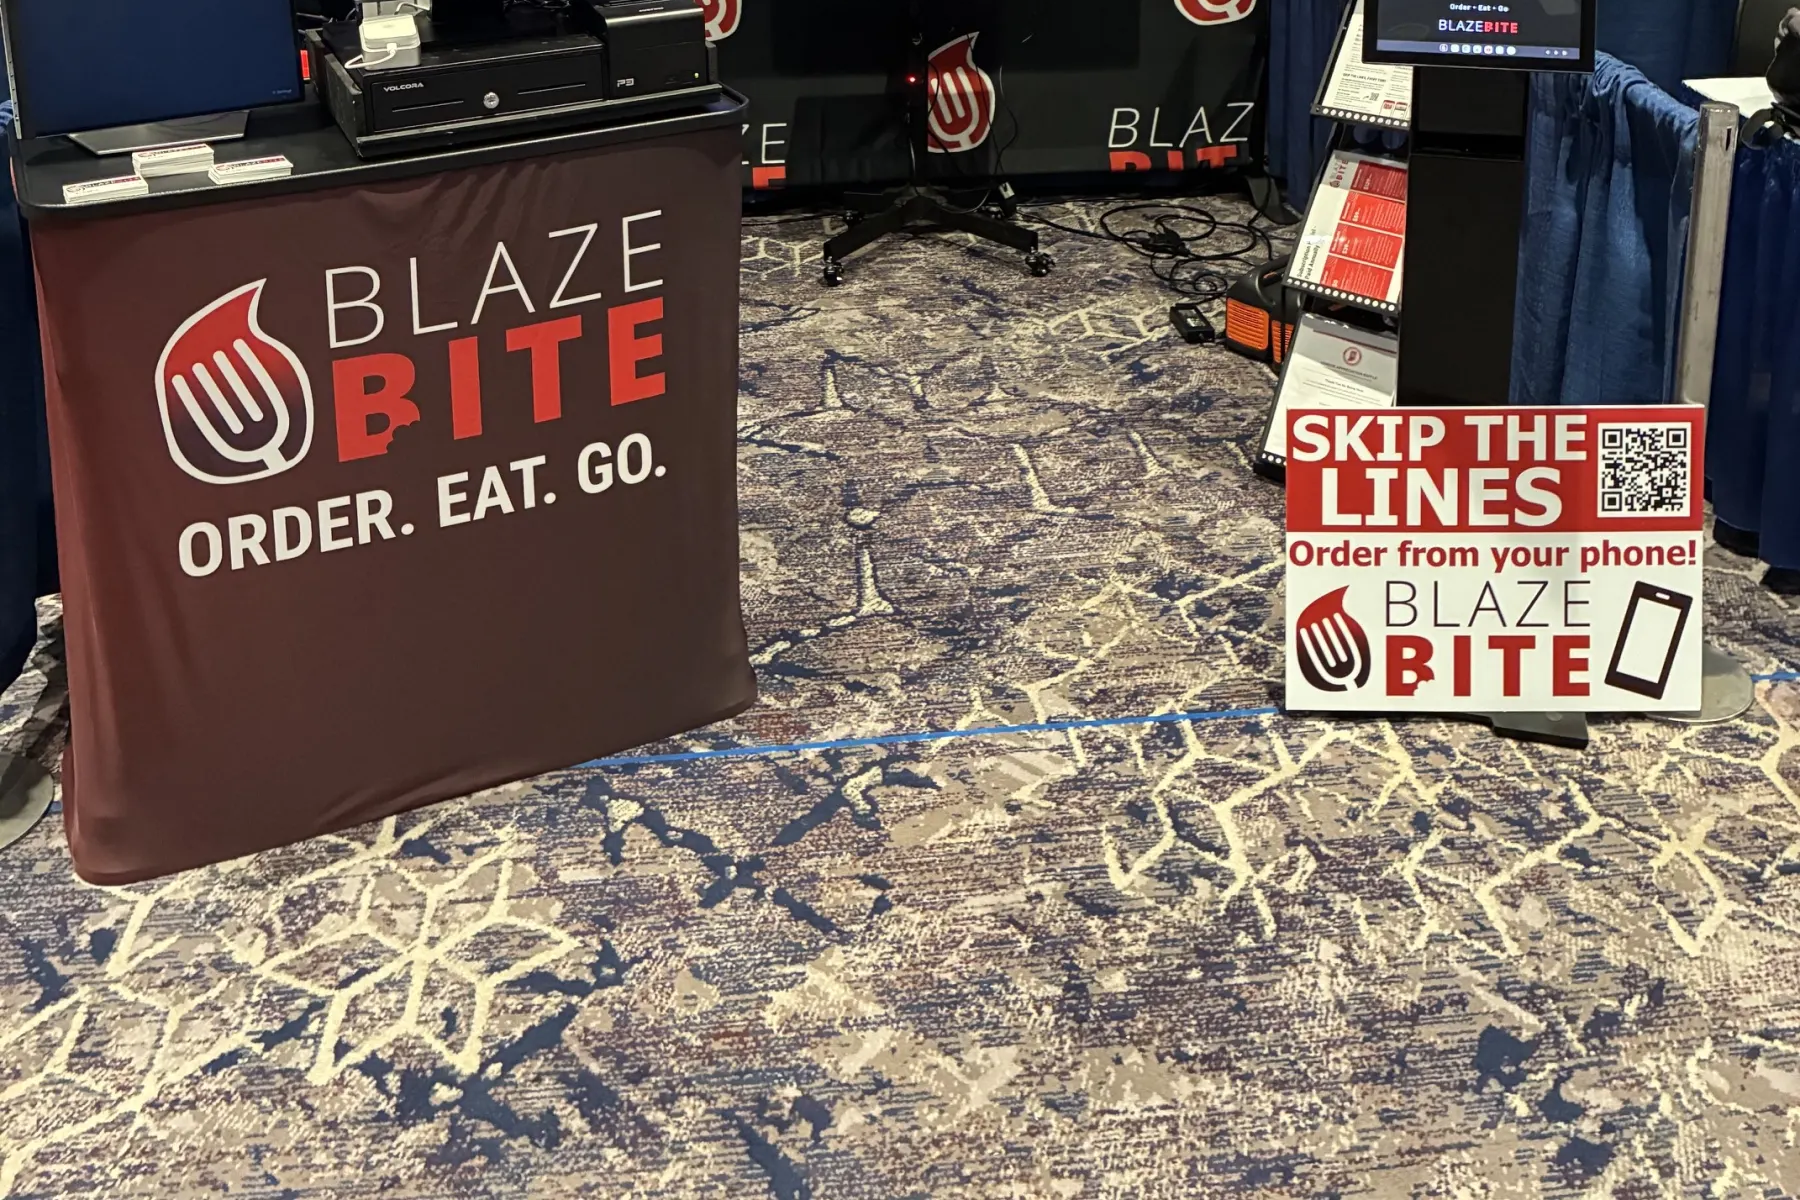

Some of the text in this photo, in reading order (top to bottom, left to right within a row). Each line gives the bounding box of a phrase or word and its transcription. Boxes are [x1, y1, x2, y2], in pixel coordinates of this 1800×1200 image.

[1450, 3, 1471, 11] Order
[1478, 4, 1491, 12] Eat
[383, 82, 424, 93] VOLCORA
[1109, 102, 1254, 148] BLAZ
[325, 209, 664, 349] BLAZE
[331, 297, 666, 462] BITE
[1292, 414, 1588, 462] SKIP THE
[178, 433, 667, 577] ORDER. EAT. GO.
[1321, 466, 1563, 527] LINES
[1289, 540, 1697, 573] Order from your phone!
[1385, 580, 1591, 628] BLAZE
[1385, 635, 1591, 697] BITE
